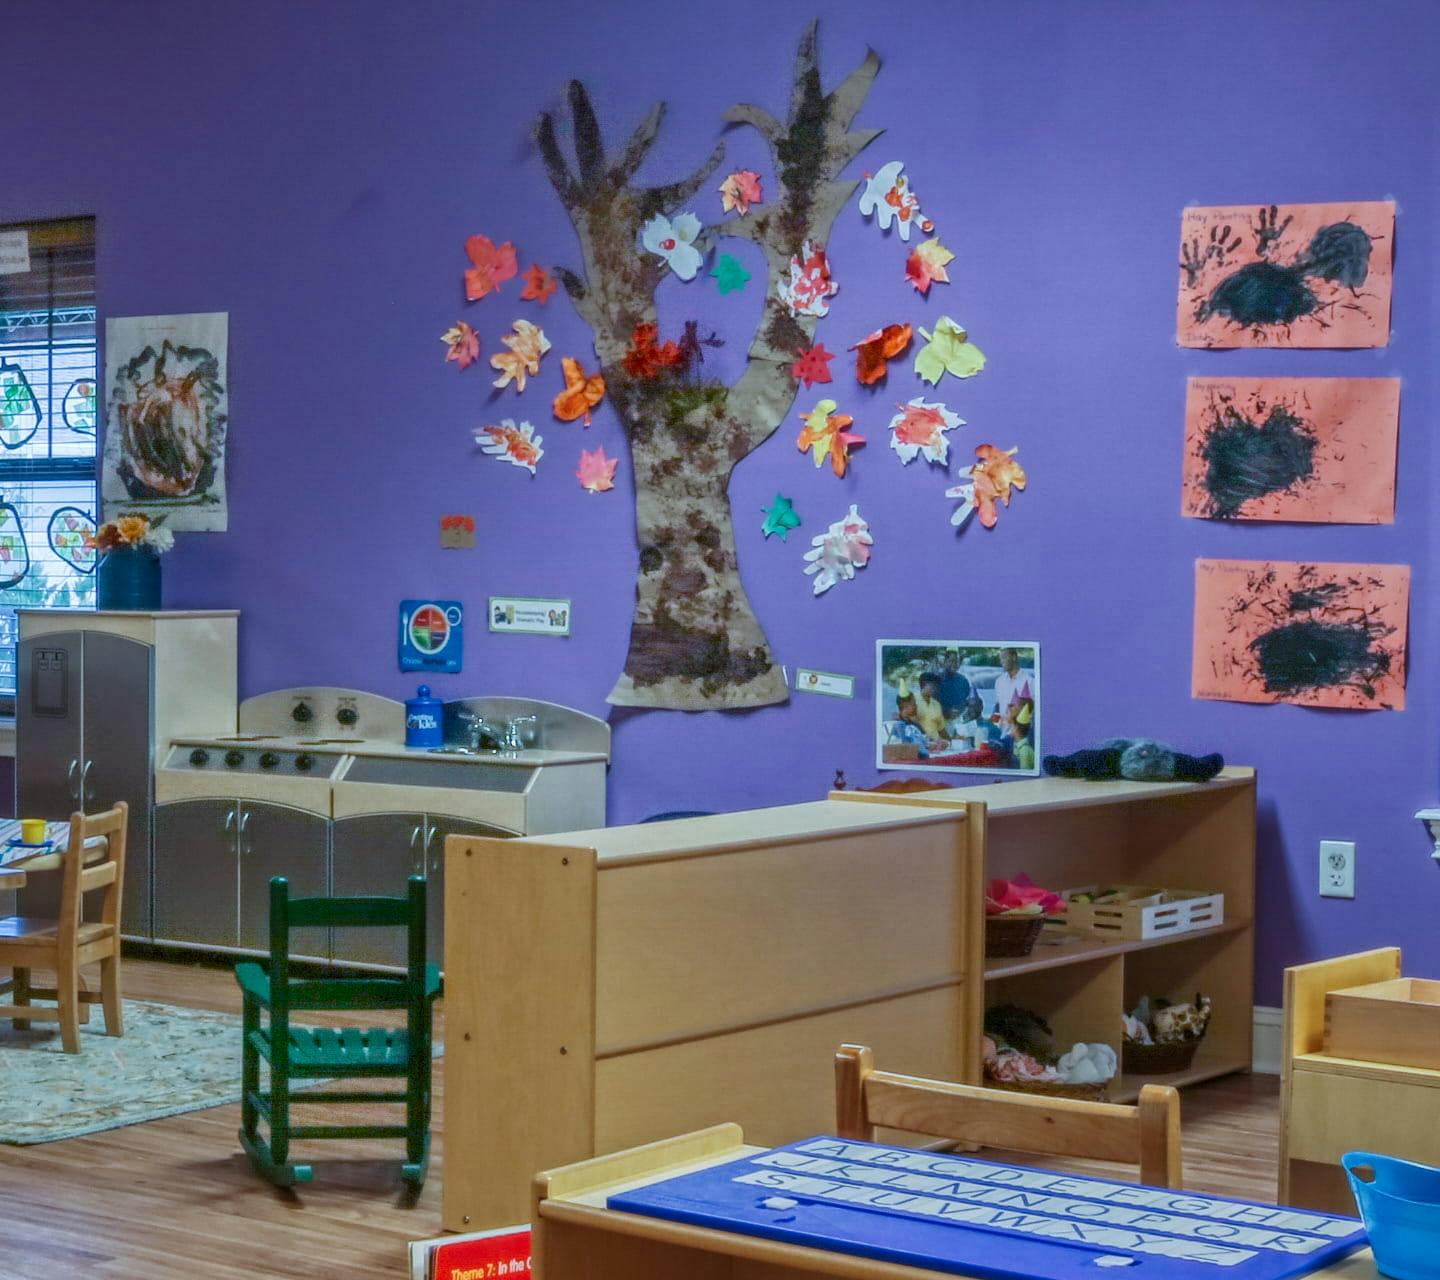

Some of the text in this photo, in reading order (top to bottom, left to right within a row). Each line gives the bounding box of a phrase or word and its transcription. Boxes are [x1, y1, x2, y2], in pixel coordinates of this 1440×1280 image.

[755, 1174, 1242, 1263] S T U V W X Y Z
[772, 1159, 1307, 1249] J K L M N O P Q R
[812, 1144, 1342, 1232] A B C D E F G H I
[486, 1262, 496, 1277] 7:
[497, 1261, 508, 1276] In
[509, 1258, 525, 1273] the
